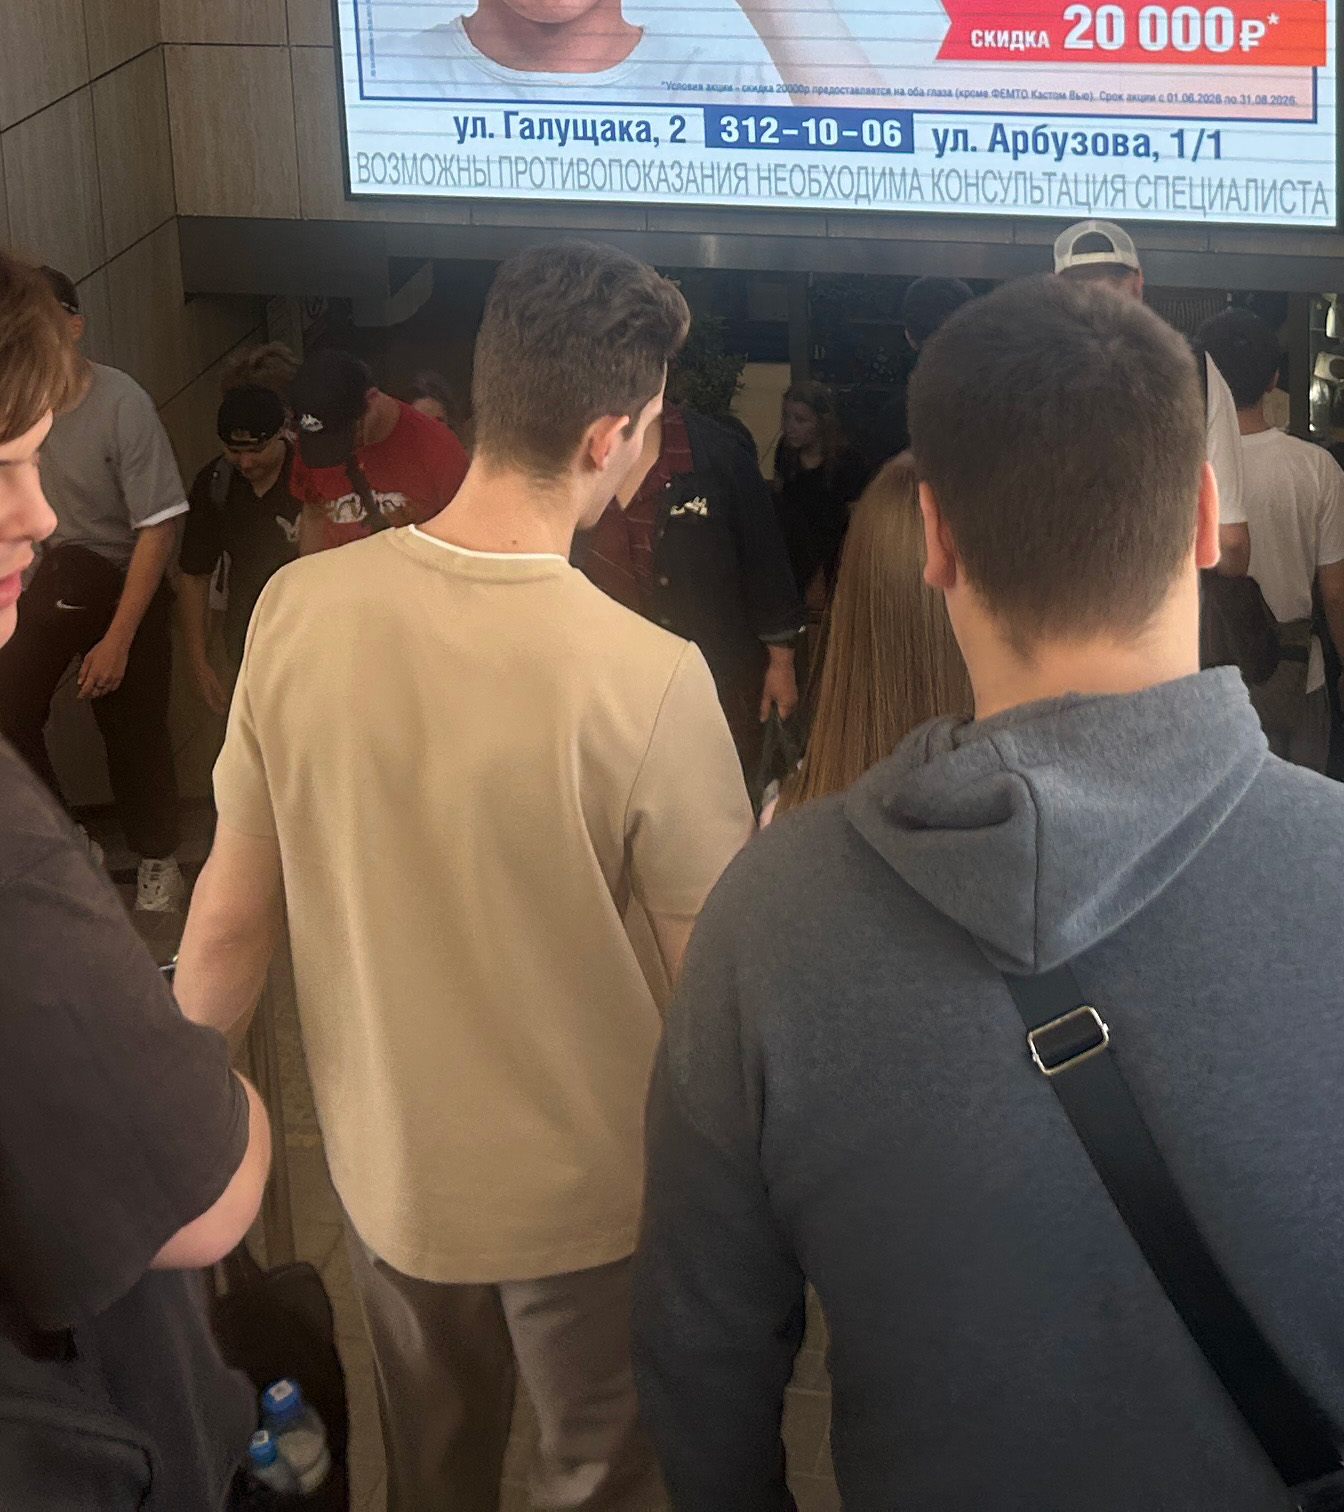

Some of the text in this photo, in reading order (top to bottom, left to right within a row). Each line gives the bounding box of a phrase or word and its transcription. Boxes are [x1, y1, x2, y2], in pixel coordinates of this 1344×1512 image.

[970, 28, 1050, 51] СКИДКА
[1062, 3, 1125, 51] 20
[741, 84, 774, 94] скидка
[812, 85, 892, 97] предоставляется
[894, 87, 906, 96] на
[907, 86, 925, 97] оба
[927, 88, 953, 97] глаза
[991, 89, 1029, 100] ФЕМТО
[1099, 90, 1124, 103] Срок
[453, 110, 687, 148] ул. Галущака, 2
[720, 116, 902, 148] 312-10-06
[931, 123, 1223, 163] ул. Арбузова, 1/1
[356, 152, 1330, 219] ВОЗМОЖНЫ ПРОТИВОПОКАЗАНИЯ НЕОБХОДИМА КОНСУЛЬТАЦИЯ СПЕЦИАЛИСТА
